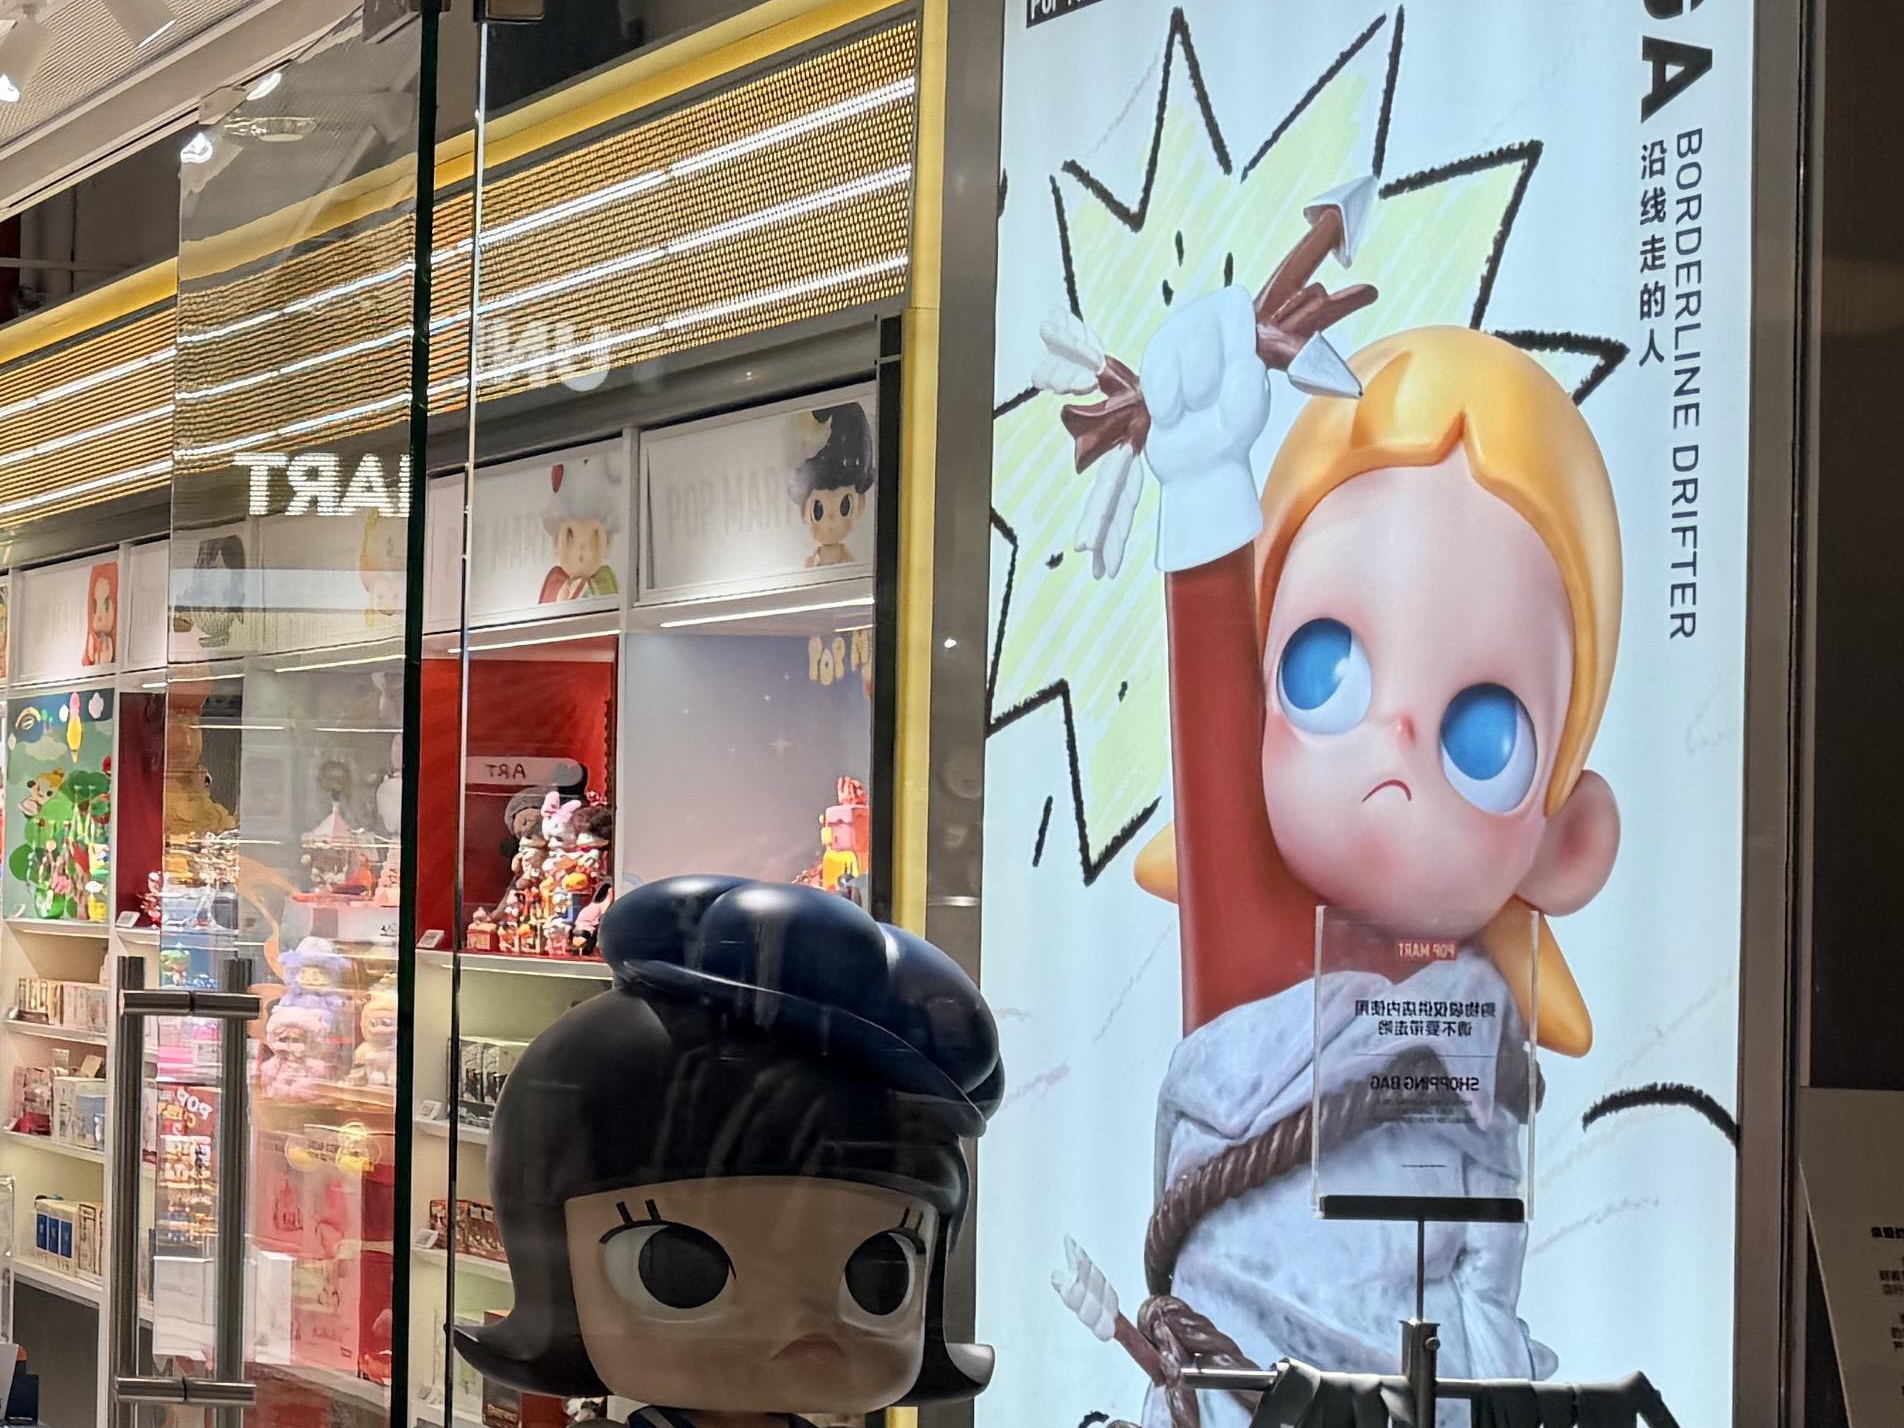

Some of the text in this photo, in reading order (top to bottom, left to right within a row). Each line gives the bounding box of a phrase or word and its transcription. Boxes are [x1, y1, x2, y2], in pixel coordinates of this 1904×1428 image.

[1638, 139, 1668, 368] 沿线走的人
[1668, 127, 1704, 640] BORDERLINE DRIFTER
